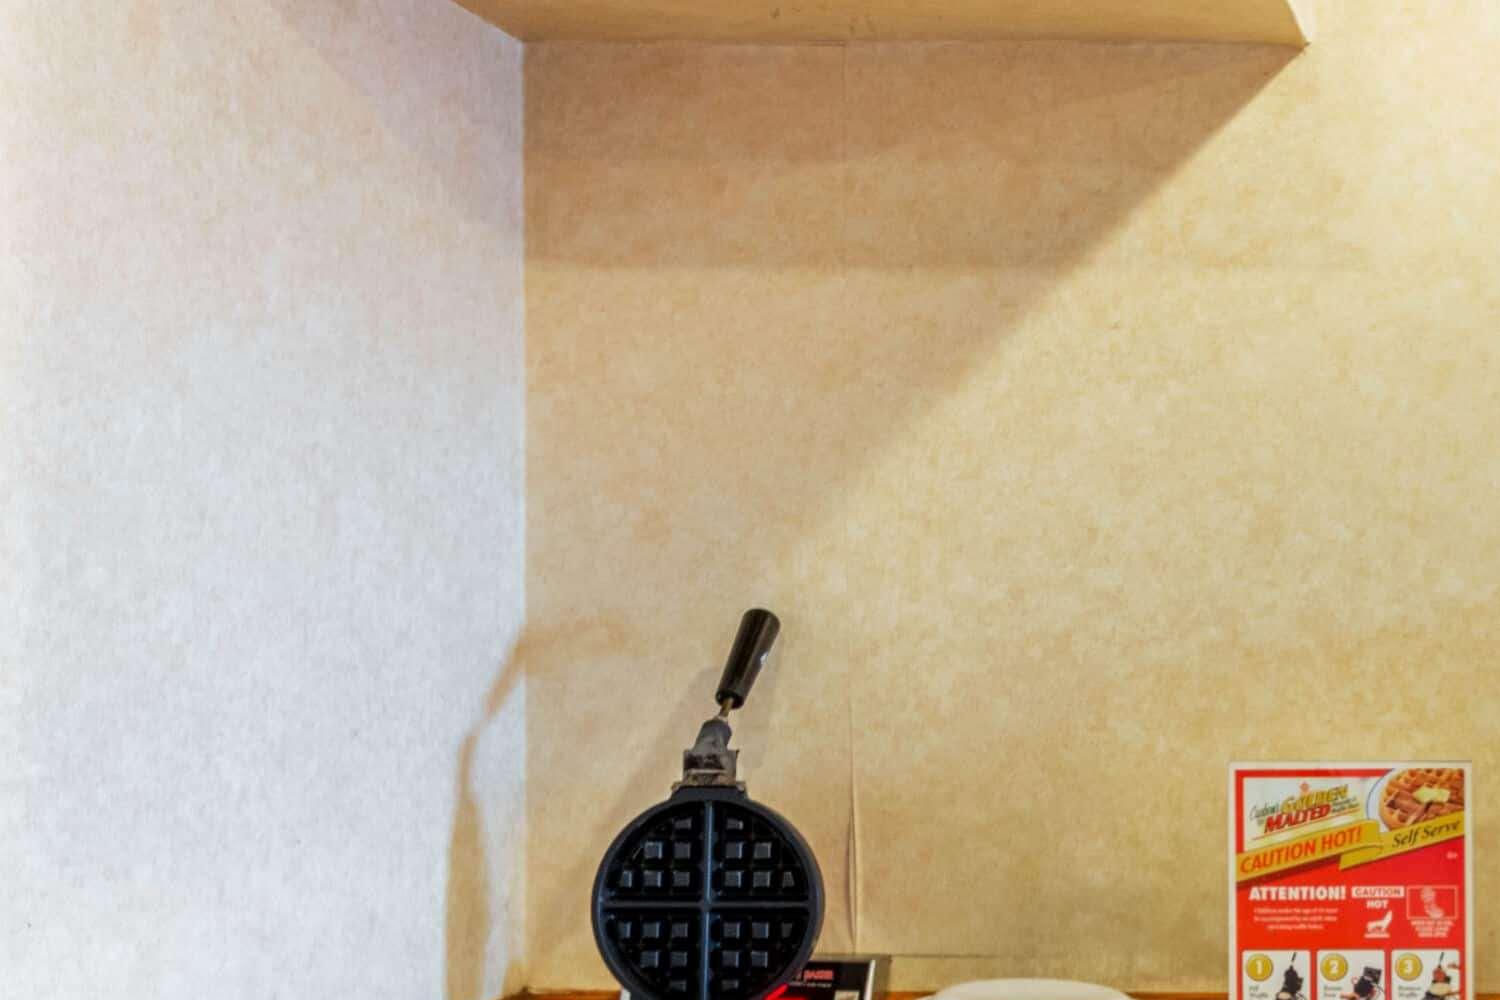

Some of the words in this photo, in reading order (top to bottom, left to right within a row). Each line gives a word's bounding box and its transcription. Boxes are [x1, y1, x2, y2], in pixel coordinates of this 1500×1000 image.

[1264, 803, 1331, 834] MALTED
[1391, 830, 1420, 849] Self
[1421, 819, 1461, 840] Serve
[1239, 837, 1316, 874] CAUTION
[1320, 826, 1362, 851] HOT!
[1248, 885, 1346, 901] ATTENTION!
[1354, 887, 1402, 897] CAUTION
[1366, 899, 1389, 909] HOT
[1255, 961, 1263, 975] 1
[1330, 960, 1339, 975] 2
[1404, 960, 1413, 974] 3
